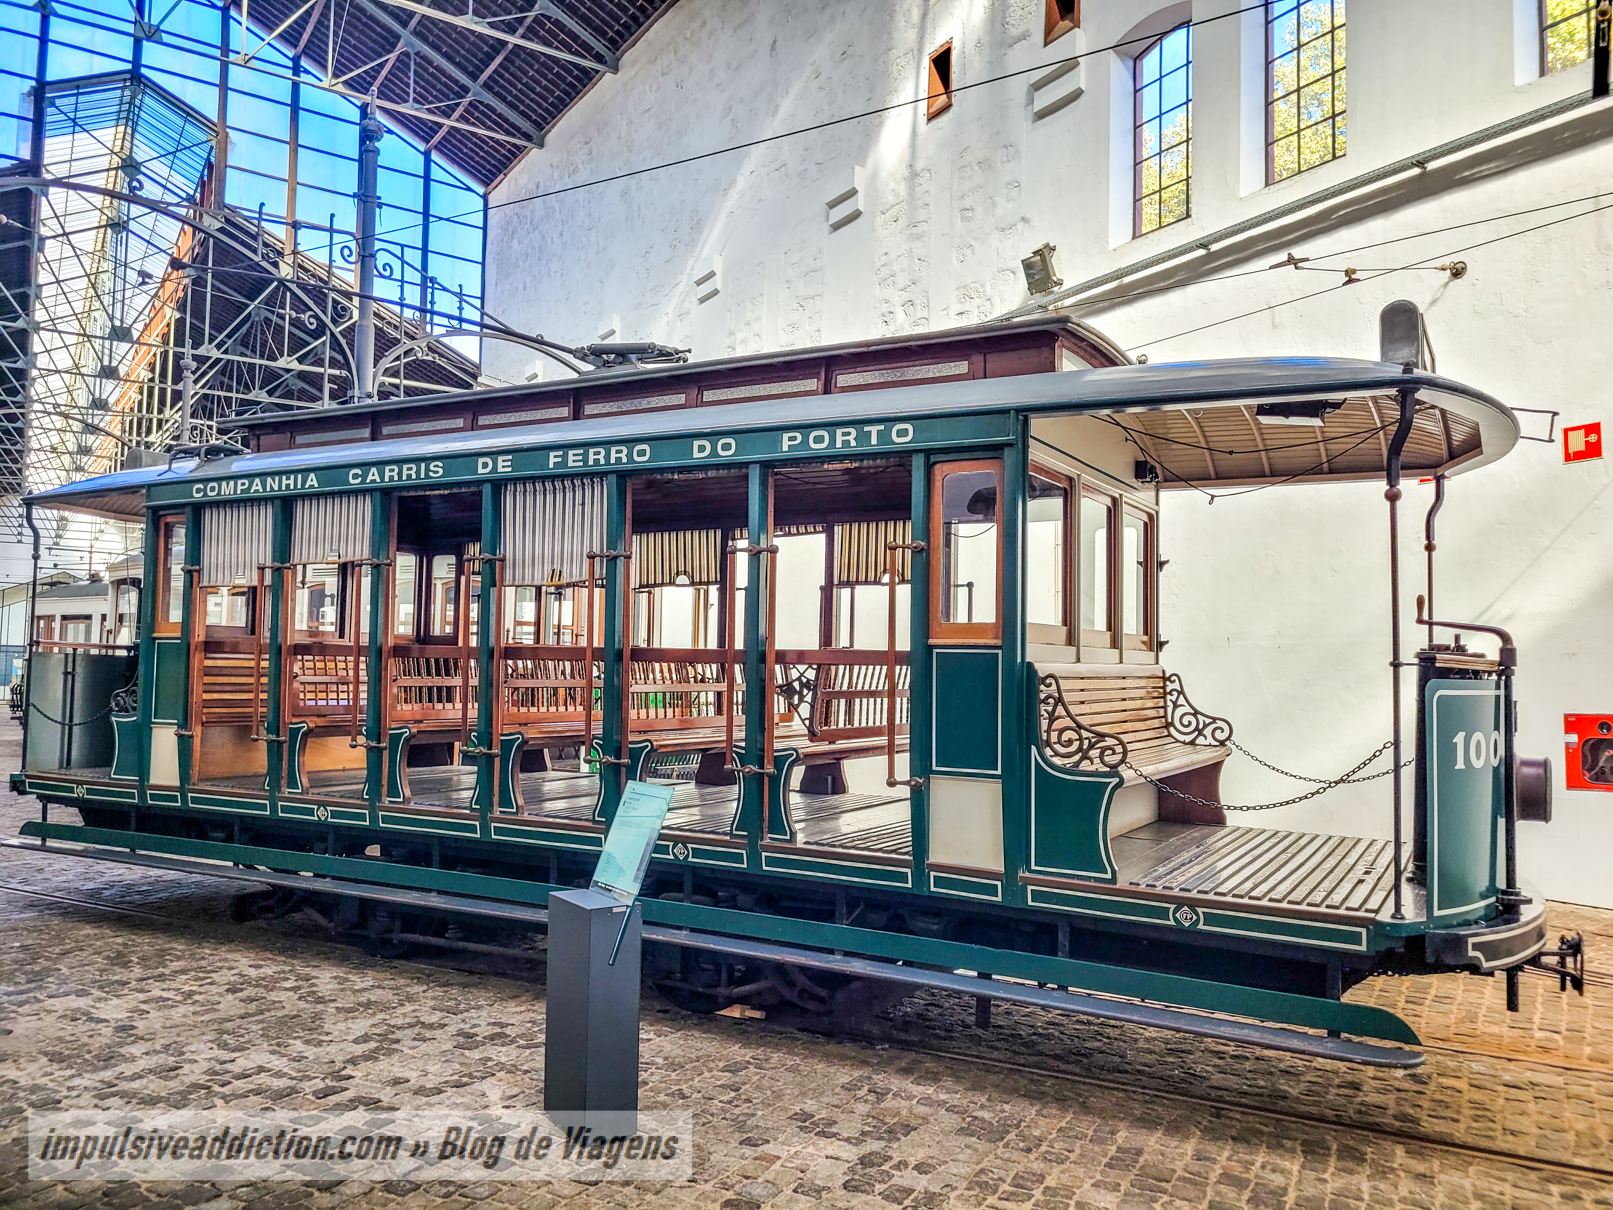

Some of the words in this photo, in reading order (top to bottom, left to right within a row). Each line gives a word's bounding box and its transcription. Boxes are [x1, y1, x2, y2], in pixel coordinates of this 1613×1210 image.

[192, 472, 319, 498] COMPANHIA
[348, 461, 444, 485] CARRIS
[477, 455, 513, 474] DE
[549, 443, 651, 469] FERRO
[692, 437, 737, 459] DO
[782, 423, 914, 452] PORTO
[1452, 730, 1501, 770] 100
